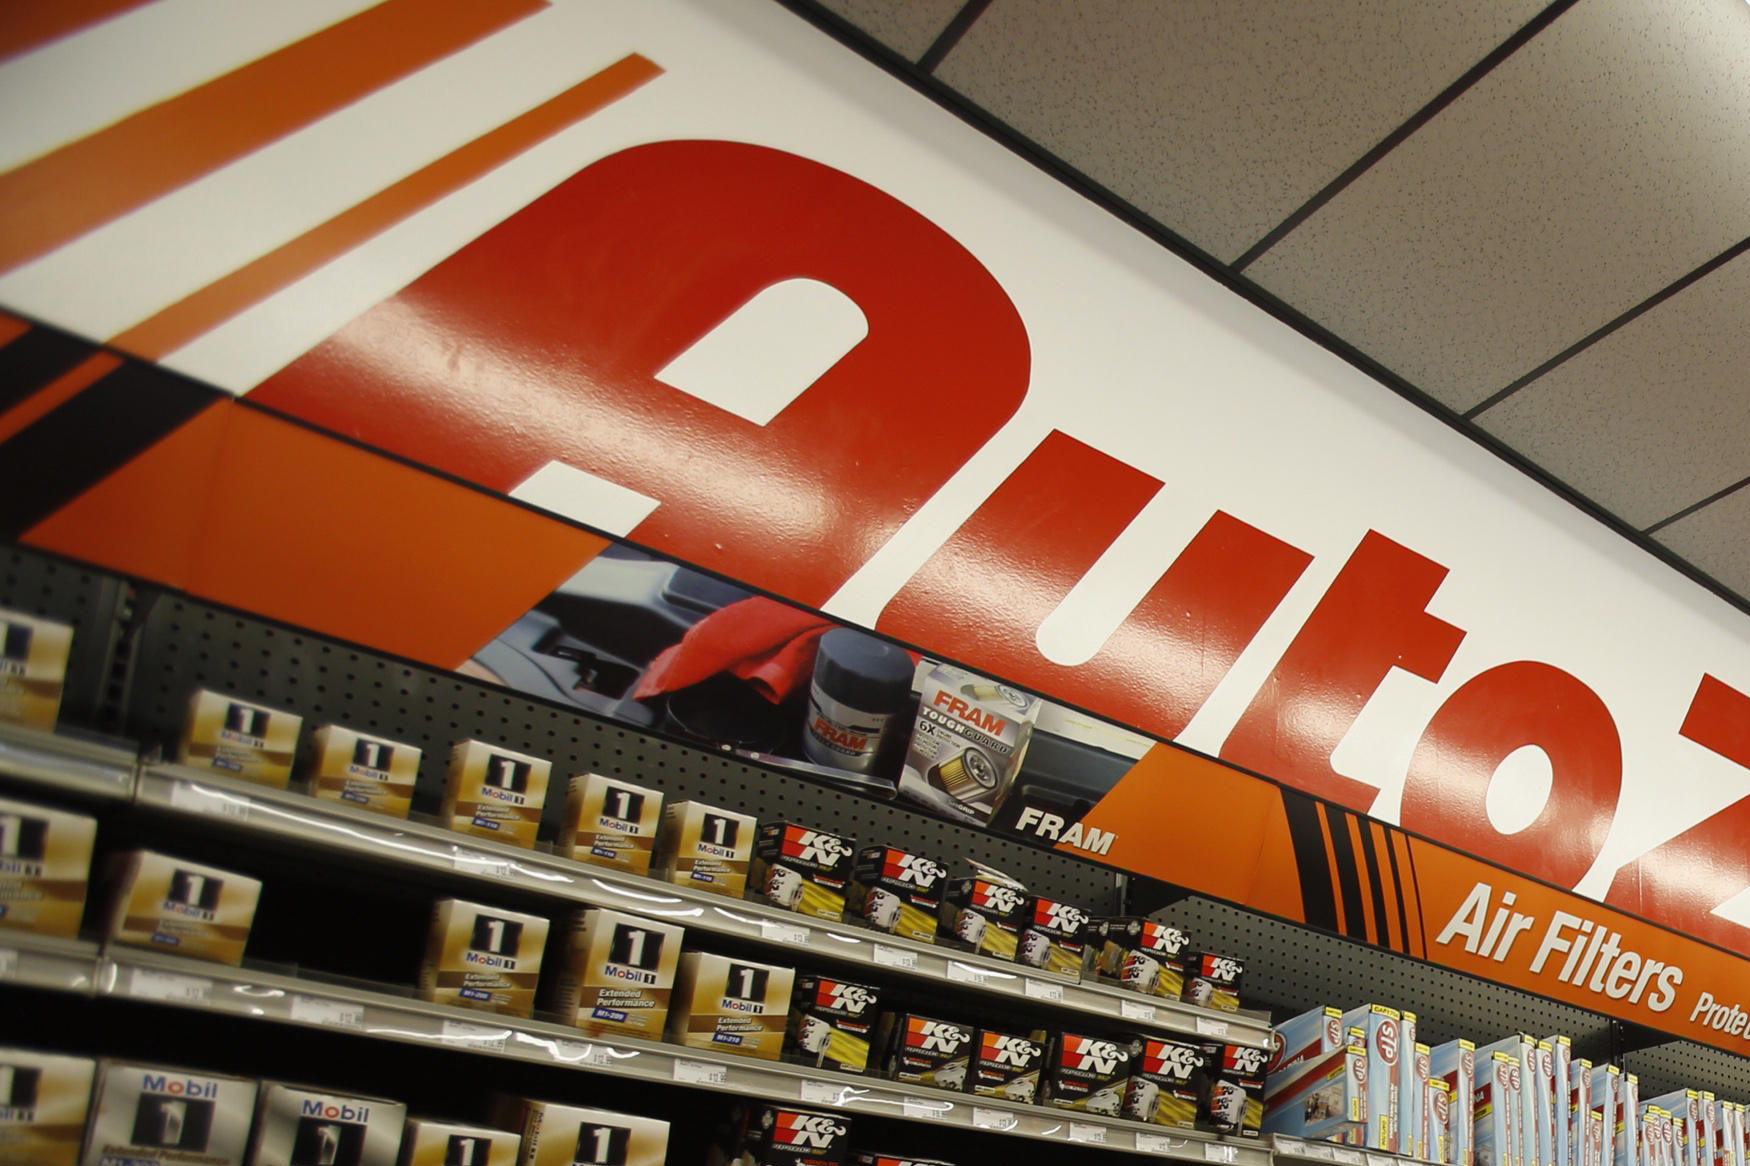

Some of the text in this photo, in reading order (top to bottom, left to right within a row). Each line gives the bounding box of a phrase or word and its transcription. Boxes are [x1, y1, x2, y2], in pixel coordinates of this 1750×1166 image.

[933, 689, 1009, 737] FRAM
[811, 716, 869, 753] FRAM
[919, 720, 936, 736] 6X
[1015, 806, 1116, 856] FRAM
[1435, 879, 1685, 1013] Air Filters
[604, 965, 643, 982] Mobil
[597, 997, 655, 1009] Performance
[599, 988, 642, 1000] Extended
[722, 999, 752, 1012] Mobil
[716, 1023, 763, 1032] Performance
[717, 1016, 752, 1026] Extended
[143, 1074, 218, 1098] Mobil
[302, 1100, 369, 1123] Mobil
[790, 1113, 846, 1148] K&N
[103, 1145, 231, 1166] Extended Performance
